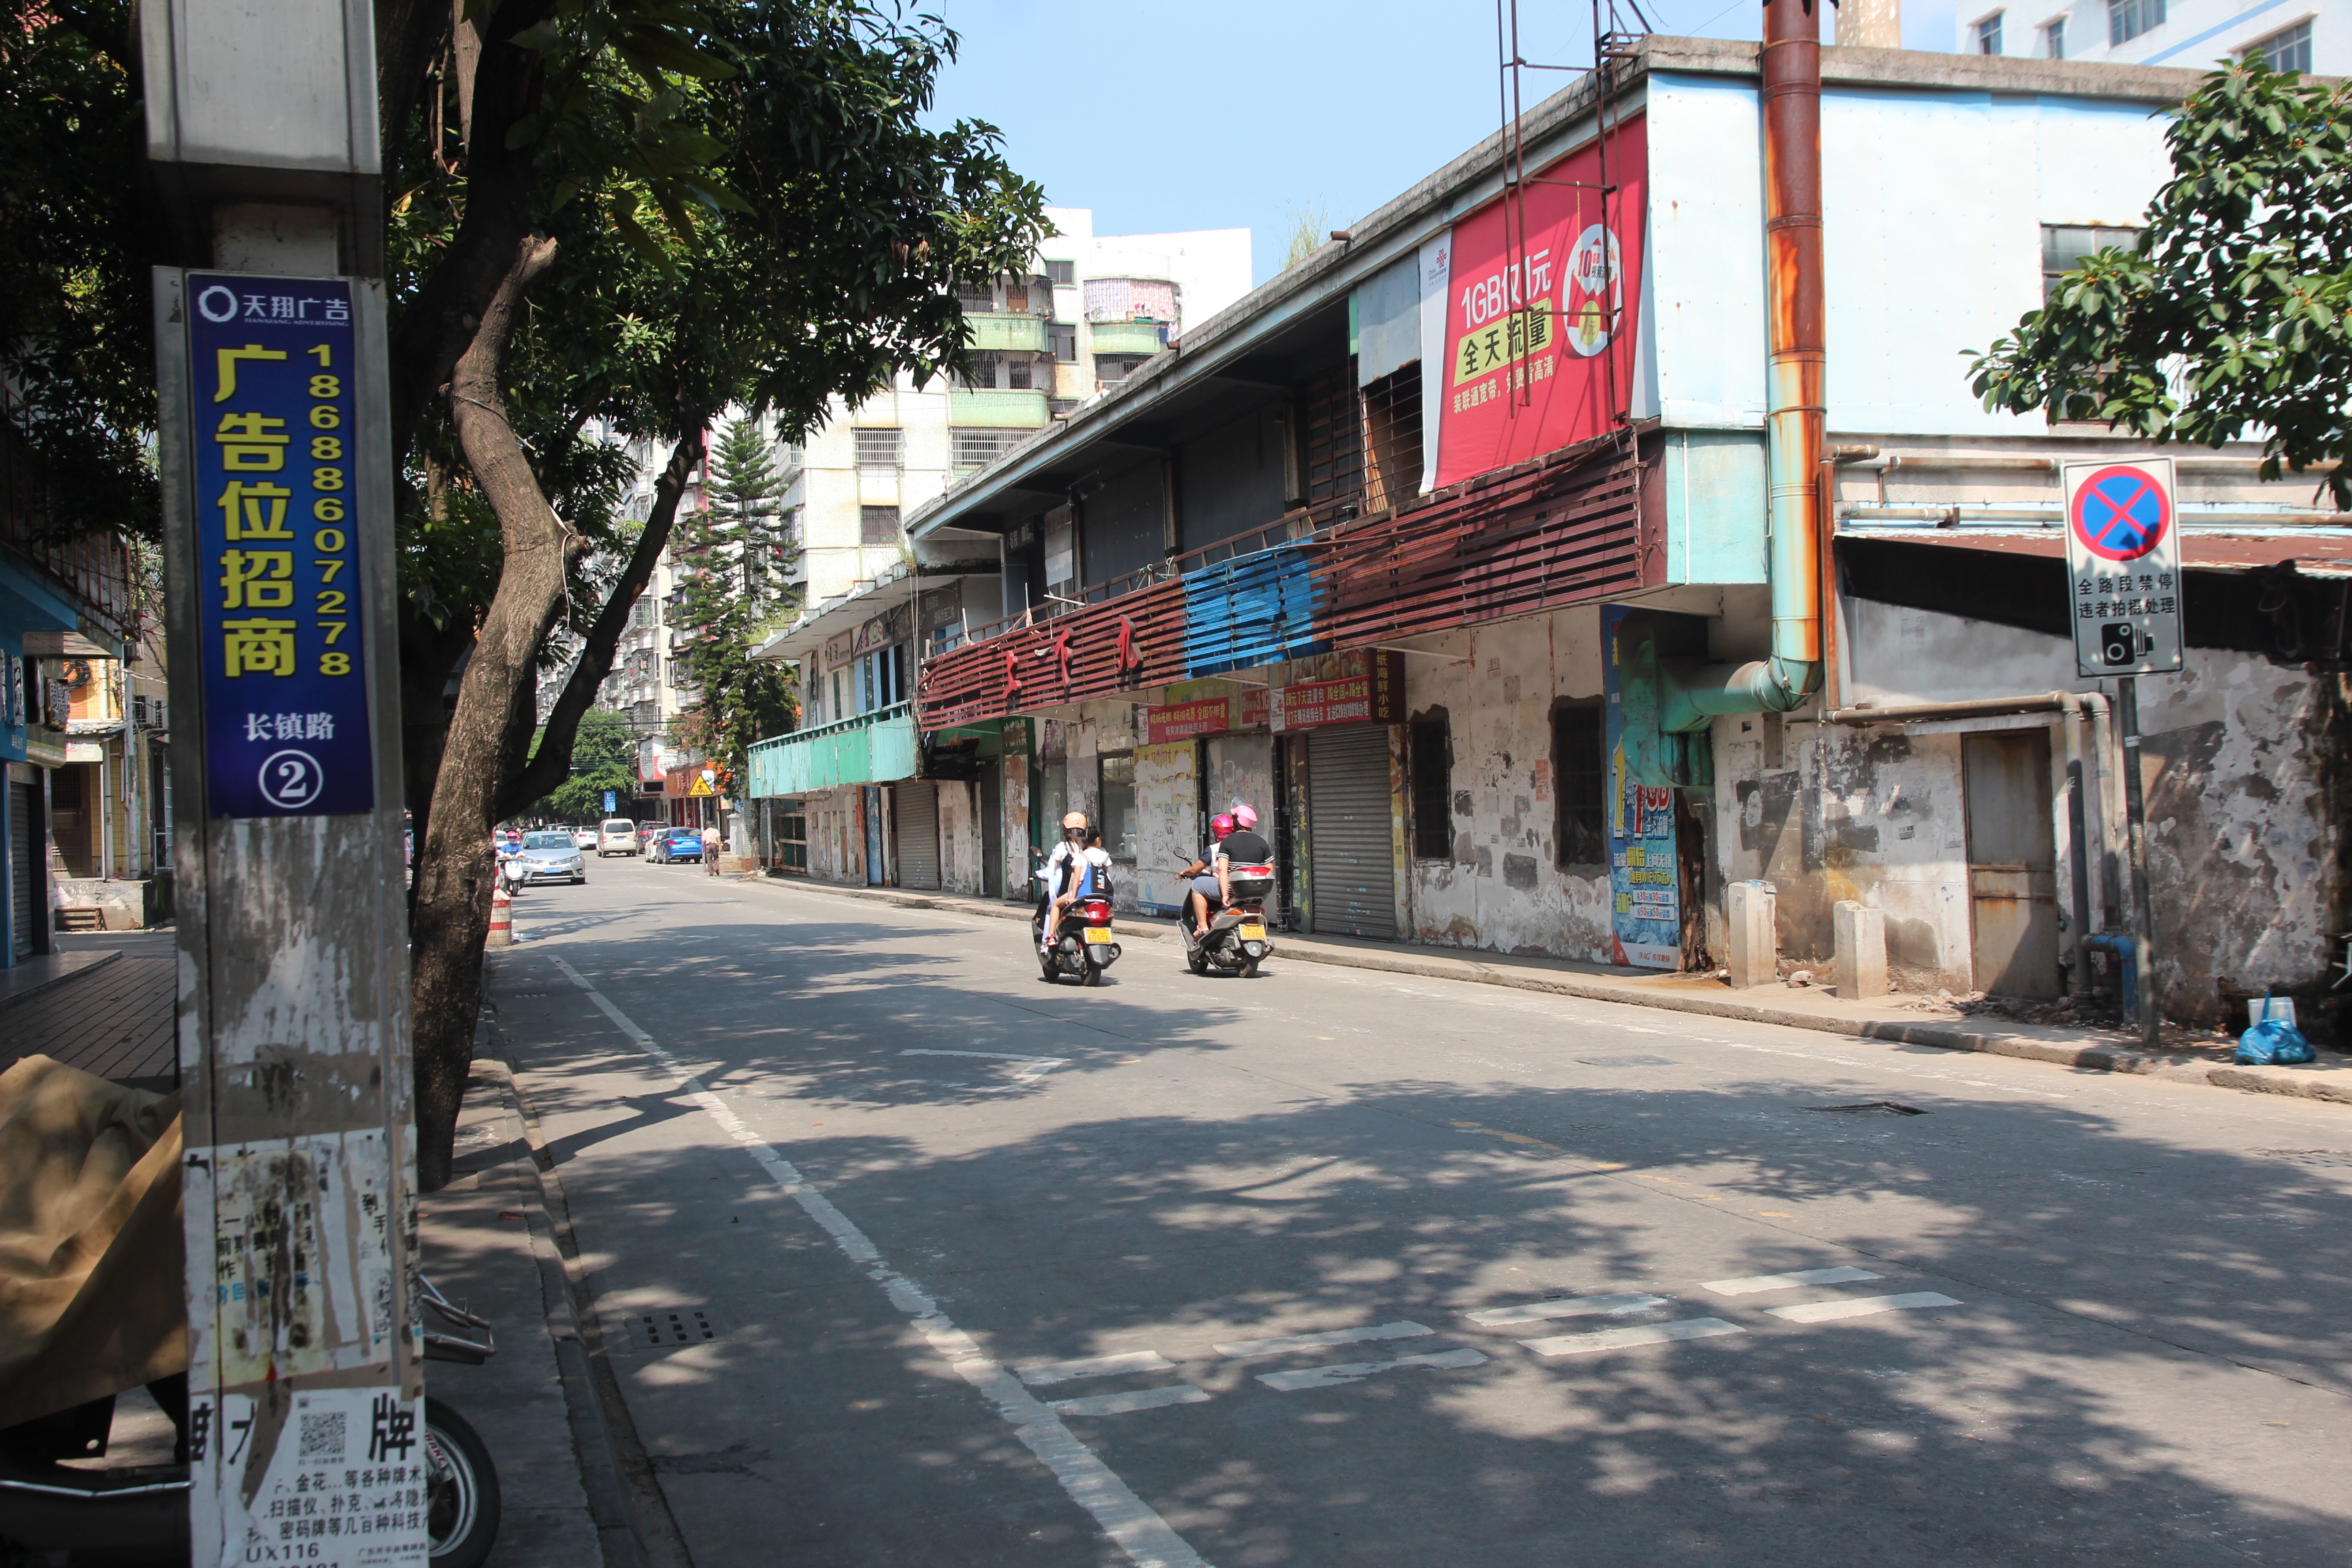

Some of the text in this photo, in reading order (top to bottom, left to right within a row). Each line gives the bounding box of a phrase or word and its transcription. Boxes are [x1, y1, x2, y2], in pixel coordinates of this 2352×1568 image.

[243, 295, 349, 320] 天翔广告
[1464, 307, 1547, 376] 全天流量
[214, 344, 297, 678] 广告位招商
[307, 344, 351, 676] 18688607278
[2078, 572, 2174, 595] 全路段禁停
[2078, 597, 2176, 619] 违者拍摄处理
[242, 713, 335, 741] 长镇路
